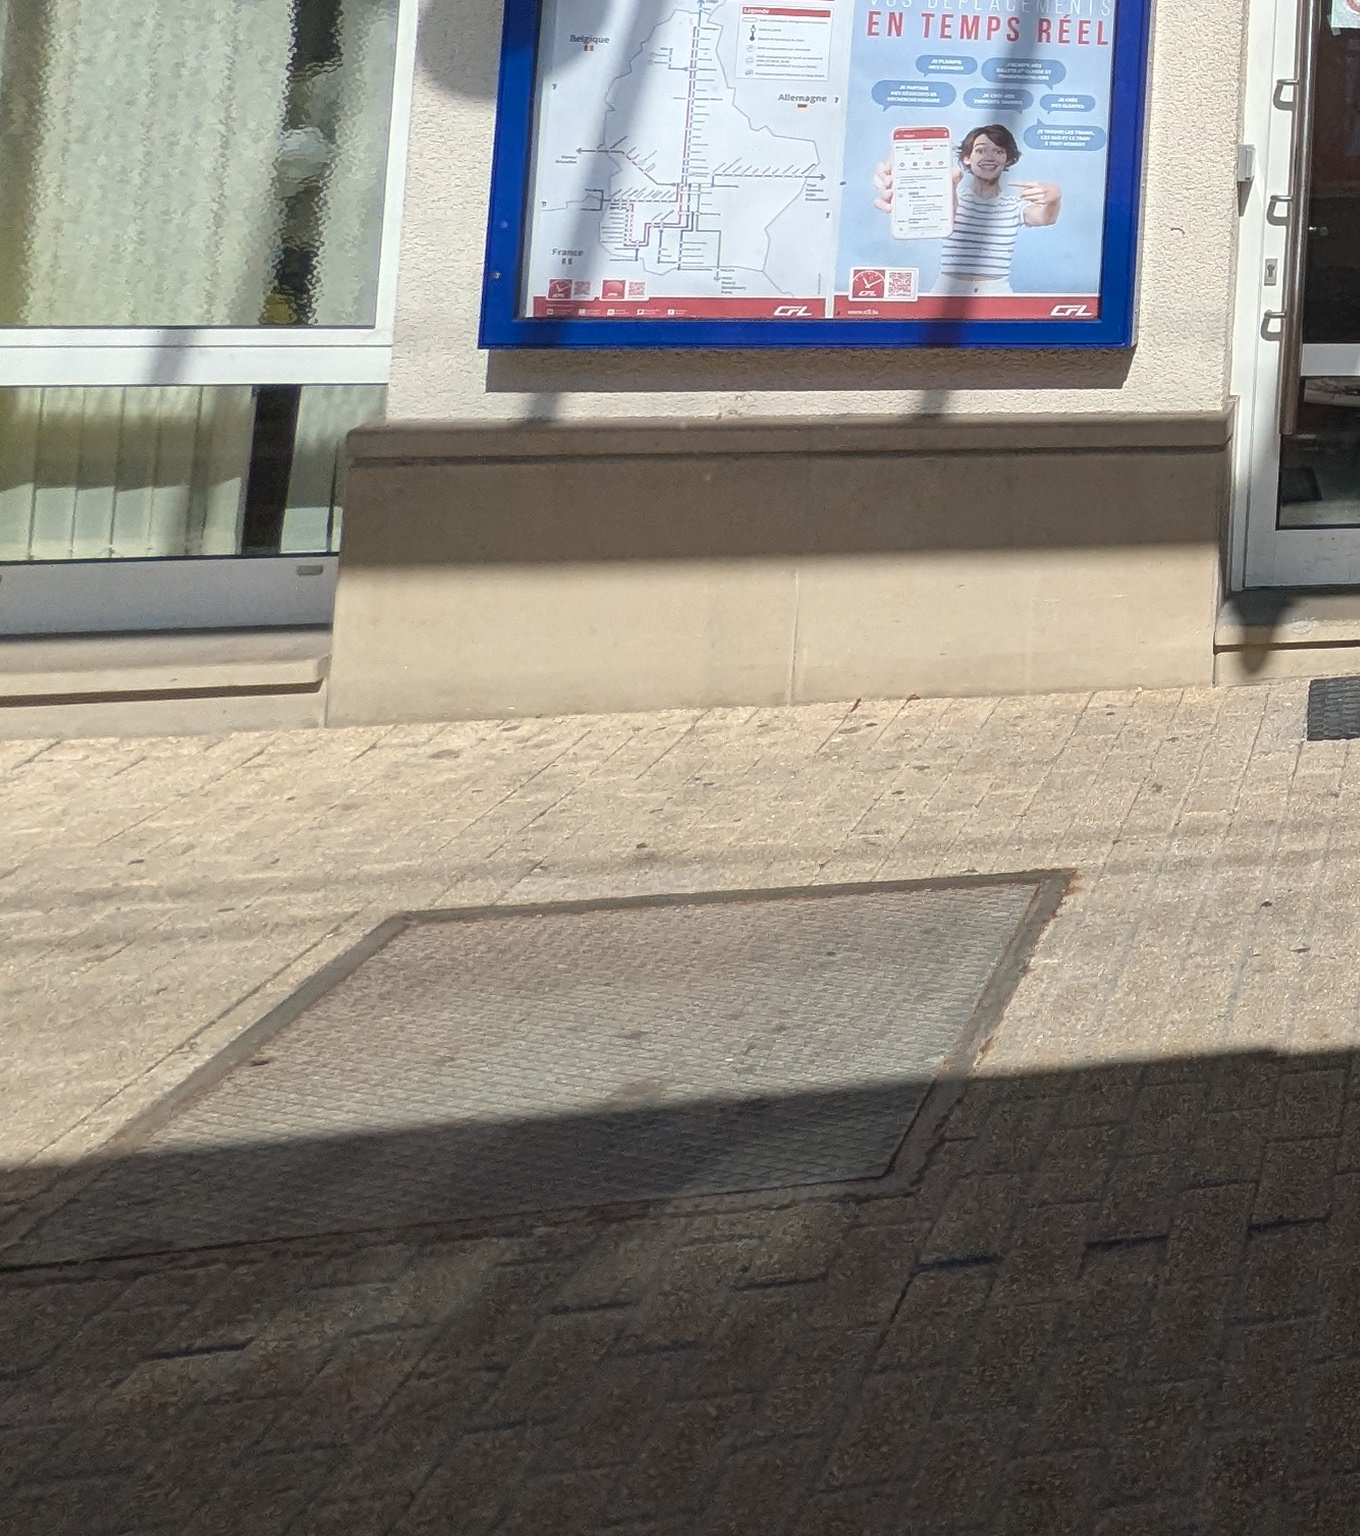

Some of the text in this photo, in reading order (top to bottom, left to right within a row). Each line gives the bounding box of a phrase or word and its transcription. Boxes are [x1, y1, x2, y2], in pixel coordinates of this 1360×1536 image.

[867, 10, 1110, 46] EN TEMPS RÉEL
[778, 93, 827, 105] Allemagne
[552, 248, 585, 257] France
[773, 305, 813, 316] CFL
[1049, 304, 1093, 317] CFL
